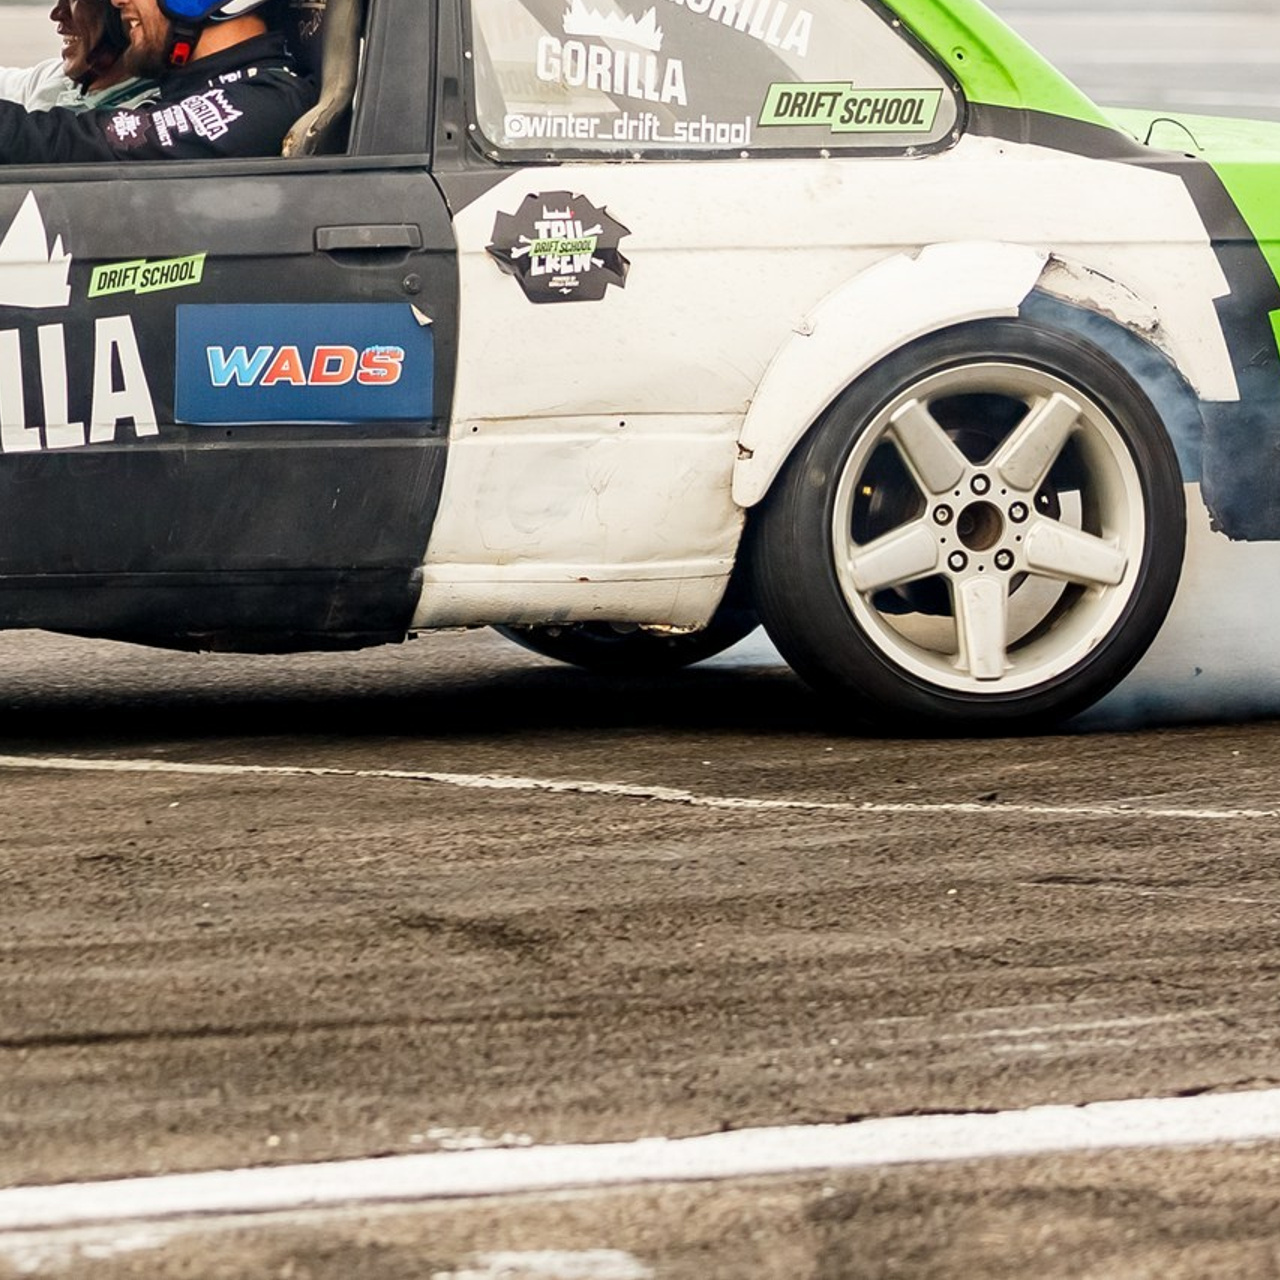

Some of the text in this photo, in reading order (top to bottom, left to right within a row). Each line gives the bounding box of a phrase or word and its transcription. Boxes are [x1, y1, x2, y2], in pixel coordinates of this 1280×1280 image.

[537, 35, 688, 106] GORILLA
[774, 92, 925, 125] DRIFT SCHOOL
[533, 240, 592, 253] DRIFT SCHOOL
[97, 261, 196, 290] DRIFT SCHOOL
[531, 254, 592, 276] CREW
[206, 343, 405, 388] WADS
